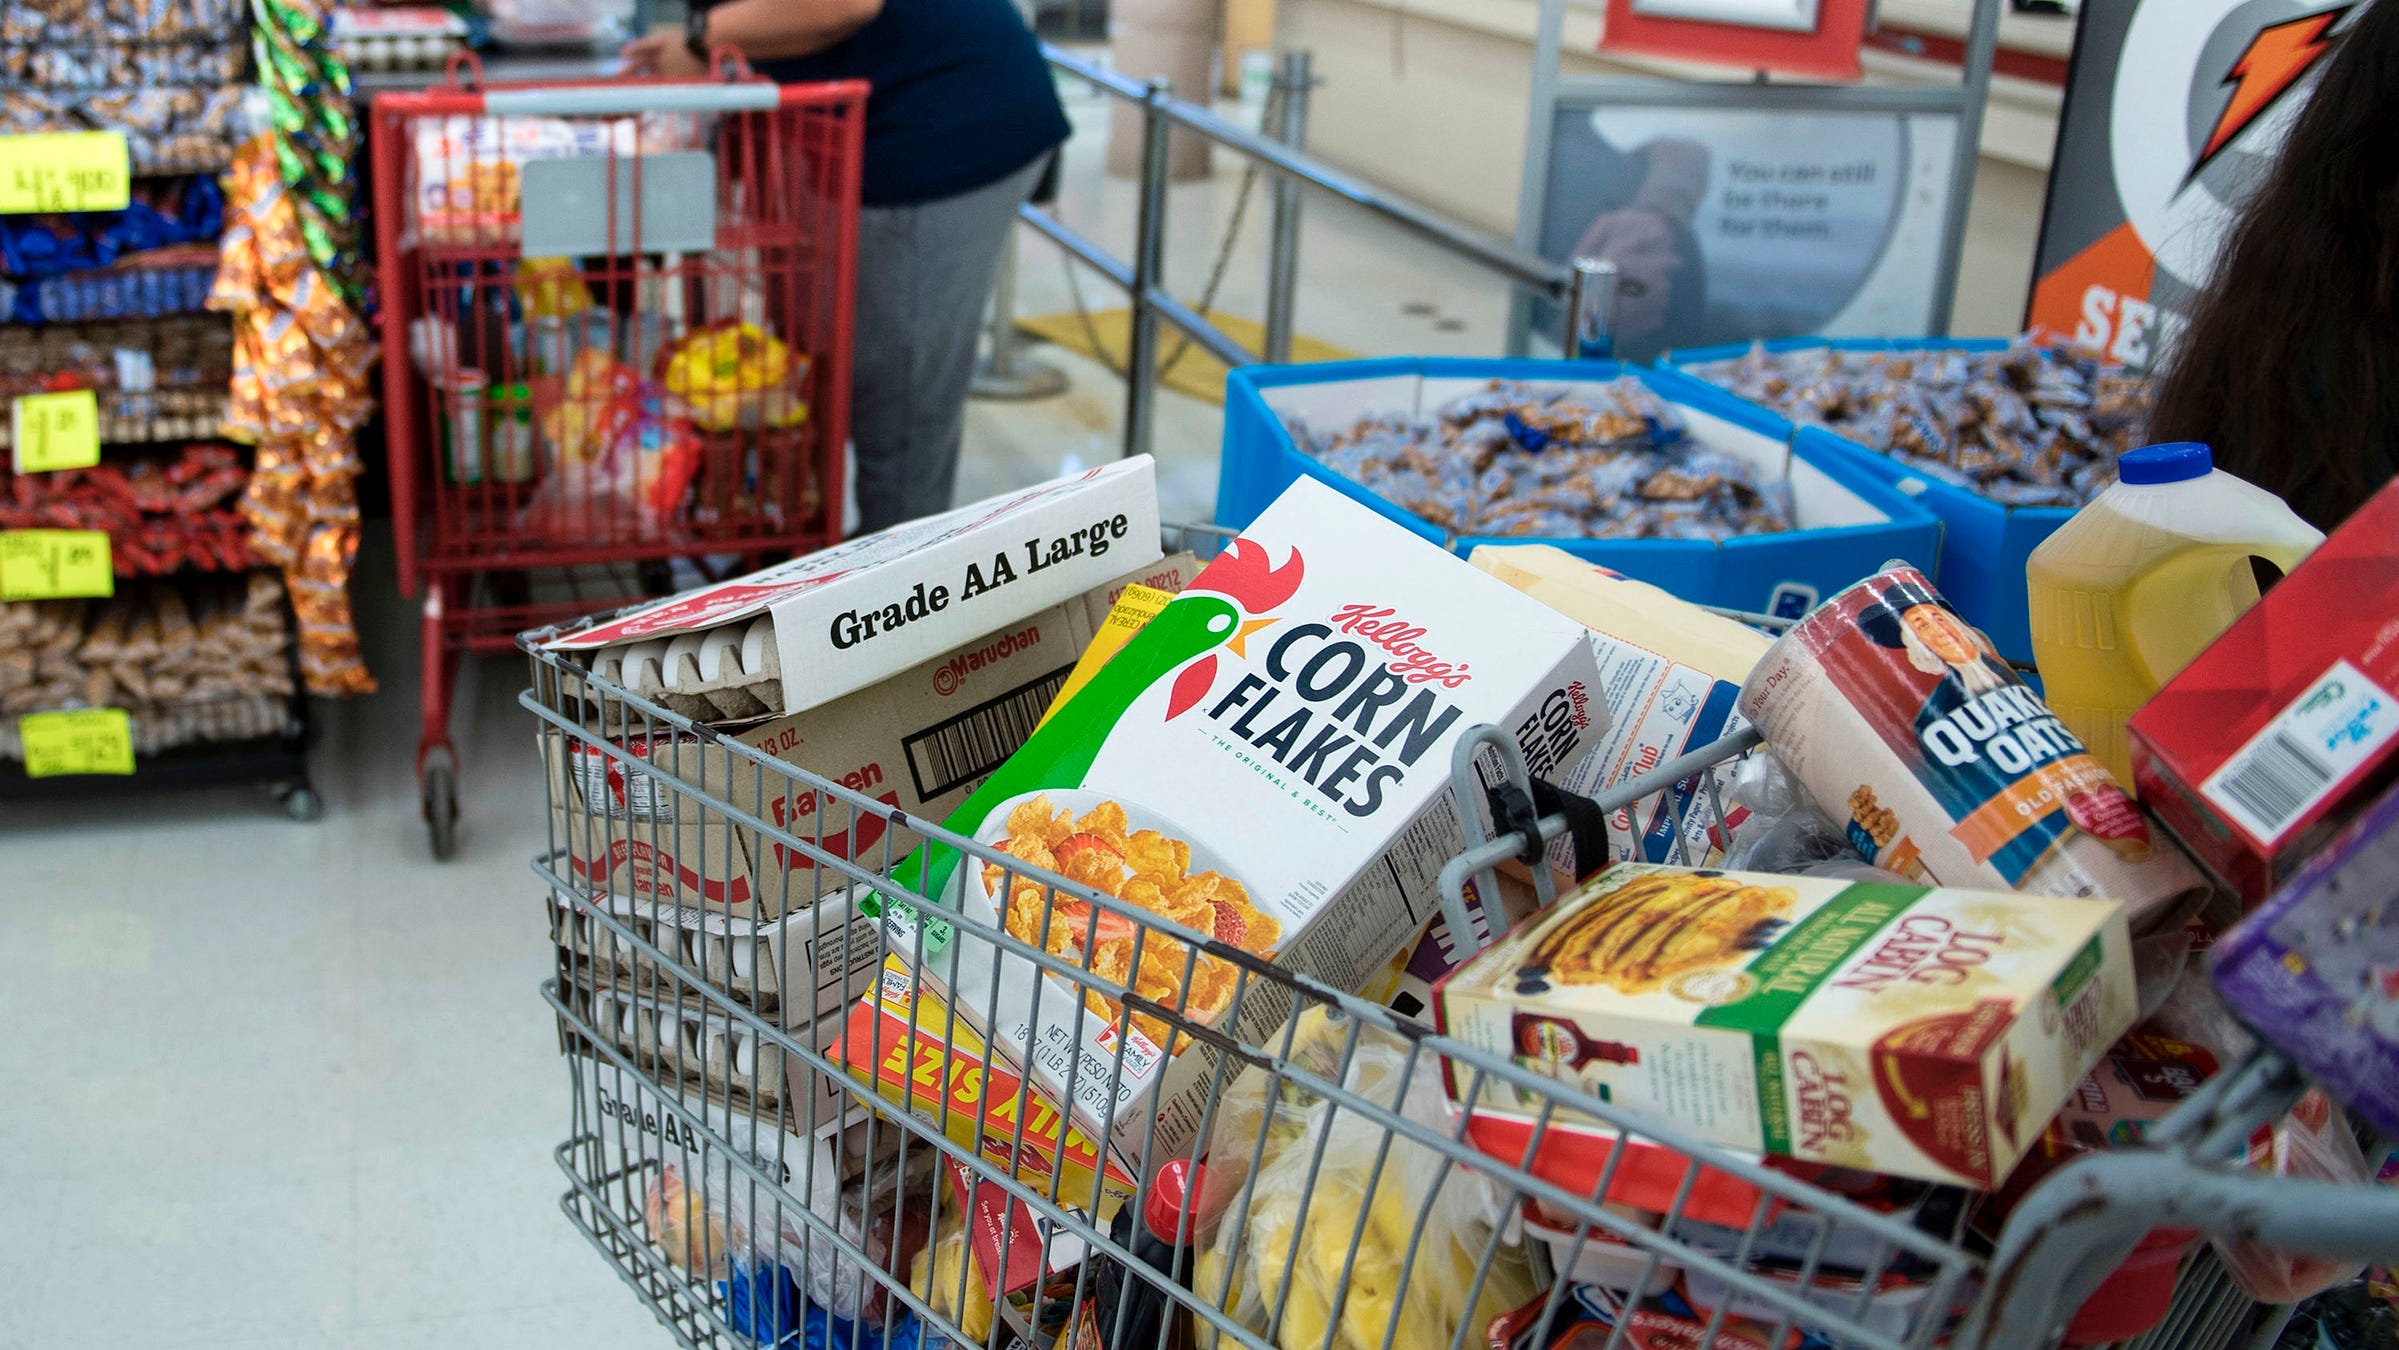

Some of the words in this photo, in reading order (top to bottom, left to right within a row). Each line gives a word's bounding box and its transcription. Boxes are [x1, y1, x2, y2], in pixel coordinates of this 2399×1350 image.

[1729, 162, 1775, 183] You
[1779, 166, 1825, 183] can
[829, 577, 950, 651] Grade
[961, 550, 1017, 600] AA
[1024, 512, 1129, 577] Large
[1123, 586, 1155, 602] (606g)
[1108, 614, 1140, 630] CEREAL
[1331, 602, 1473, 689] Kellogg's
[949, 625, 1041, 677] Maruchan
[1265, 623, 1463, 768] CORN
[1566, 681, 1590, 729] Kellogg's
[780, 727, 803, 750] OZ.
[1211, 672, 1403, 818] FLAKES
[1515, 712, 1553, 780] FLAKES
[1540, 689, 1580, 765] CORN
[1985, 719, 2085, 769] OATS
[1211, 735, 1233, 752] THE
[1235, 751, 1287, 790] ORIGINAL
[1290, 790, 1299, 799] &
[2016, 789, 2053, 817] OLD
[930, 931, 946, 944] SUGARS
[1840, 901, 1895, 924] ALL
[1833, 914, 1951, 994] CABIN
[1908, 931, 2005, 986] LOG
[1013, 1023, 1029, 1041] 18
[1046, 1052, 1064, 1073] LB
[1045, 1023, 1068, 1044] NET
[881, 1035, 993, 1104] SIZE
[1790, 1051, 1826, 1155] CABIN
[1822, 1071, 1852, 1142] LOG
[983, 1213, 993, 1226] you
[989, 1226, 996, 1234] at
